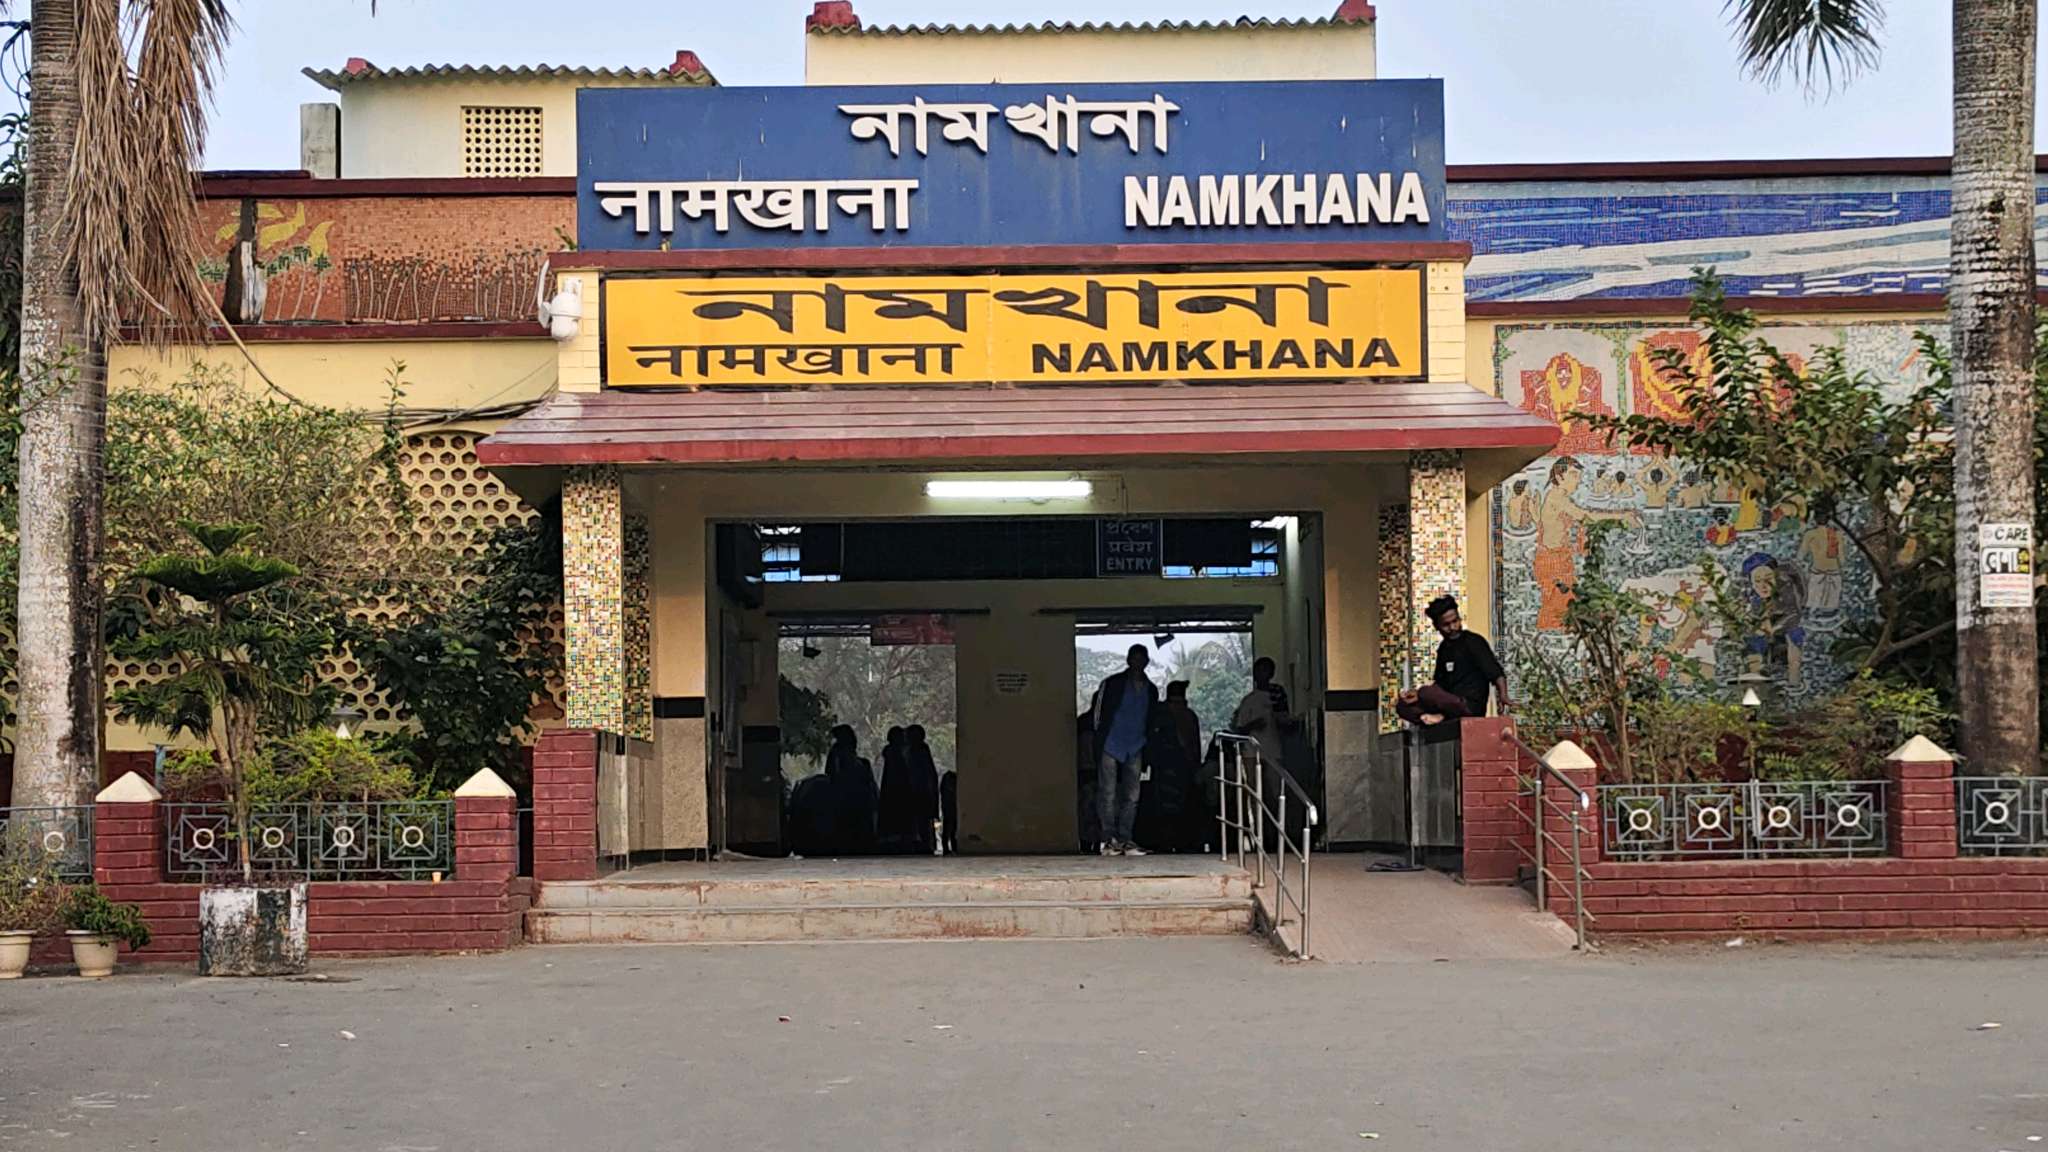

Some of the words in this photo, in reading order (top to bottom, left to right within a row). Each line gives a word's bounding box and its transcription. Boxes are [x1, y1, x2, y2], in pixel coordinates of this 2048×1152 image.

[594, 180, 919, 232] नामखाना
[1124, 172, 1430, 226] NAMKHANA
[628, 343, 964, 376] नामखाना
[1032, 338, 1400, 372] NAMKHANA
[1108, 536, 1153, 552] प्रवेश
[1106, 557, 1153, 570] ENTRY
